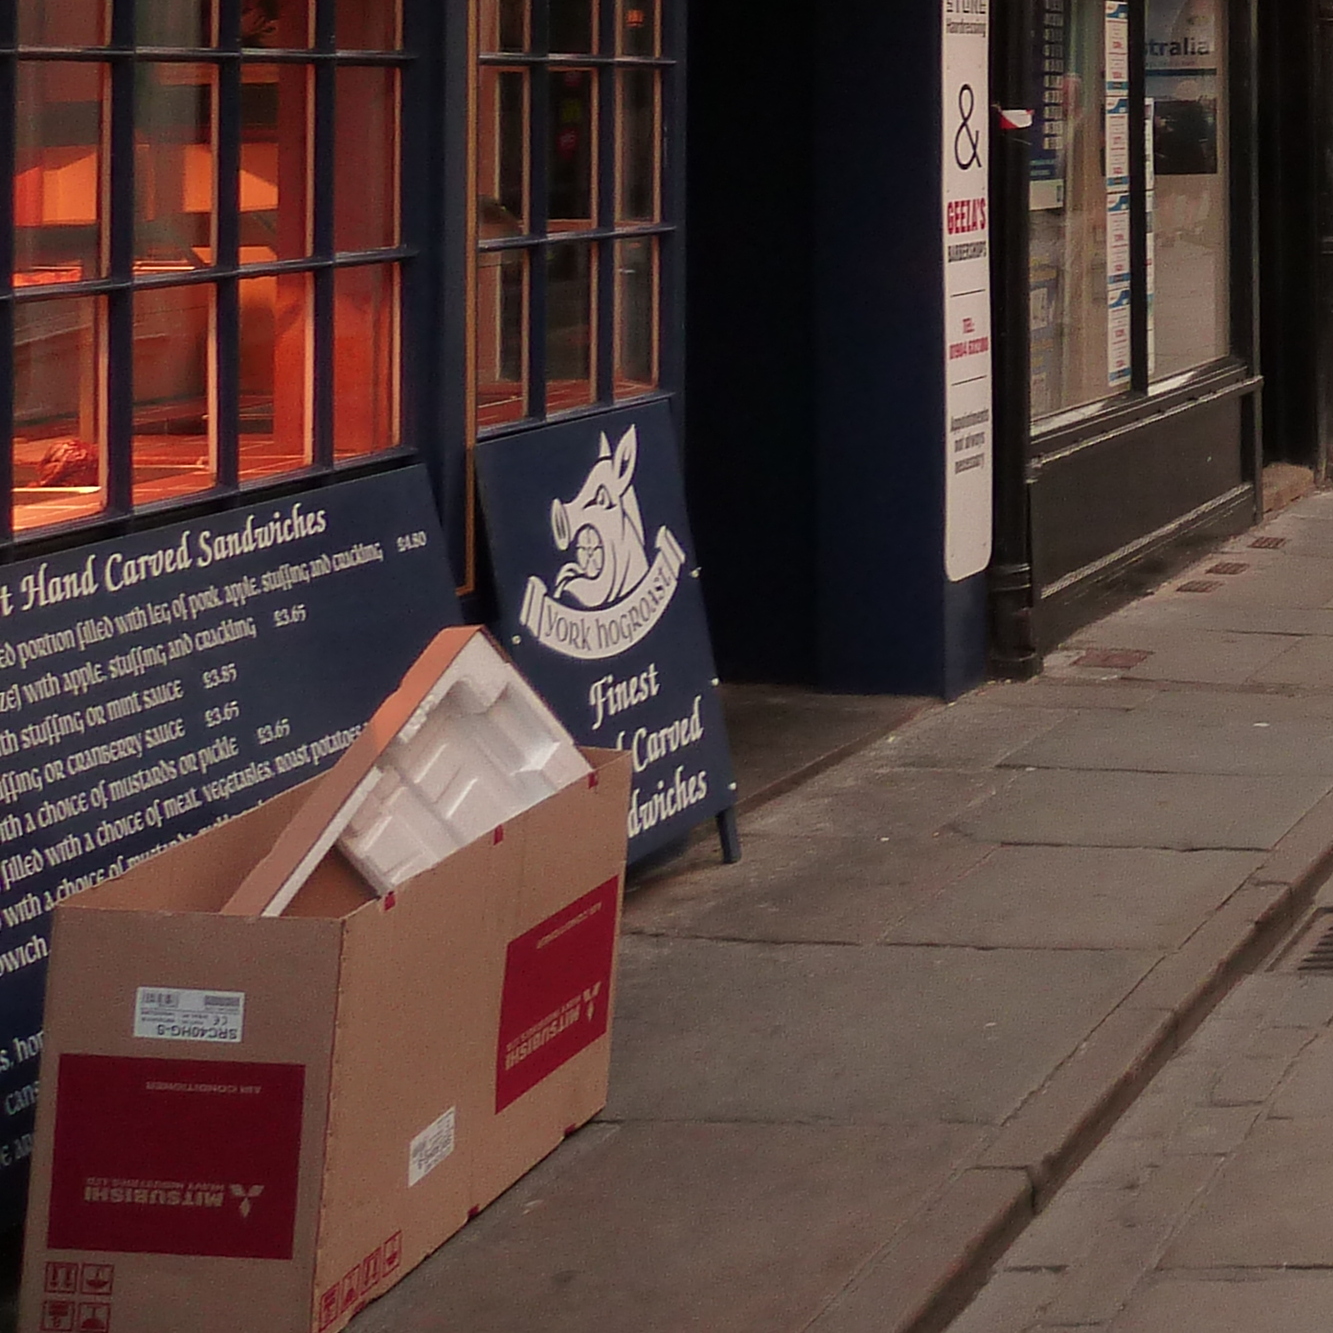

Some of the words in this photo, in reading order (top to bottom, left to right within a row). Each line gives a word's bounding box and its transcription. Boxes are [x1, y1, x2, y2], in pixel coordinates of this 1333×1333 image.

[954, 83, 982, 171] &
[947, 198, 986, 235] GEEZA'S
[20, 555, 99, 612] Hand
[104, 530, 193, 592] Carved
[196, 503, 328, 567] Sandwiches
[17, 629, 75, 671] portion
[76, 621, 115, 651] filled
[115, 606, 147, 634] with
[150, 603, 172, 626] leg
[173, 598, 188, 624] of
[262, 562, 309, 596] stuffing
[310, 554, 331, 577] and
[332, 541, 383, 571] crackling
[397, 530, 427, 553] £4.80
[22, 674, 60, 706] with
[108, 643, 167, 682] stuffing
[168, 634, 193, 660] and
[194, 616, 257, 655] crackling
[273, 603, 307, 628] £3.65
[22, 713, 85, 747] stuffing
[87, 707, 107, 726] or
[107, 692, 142, 718] mint
[142, 679, 184, 709] sauce
[203, 663, 238, 690] £3.85
[588, 663, 662, 731] Finest
[631, 694, 704, 774] Carved
[24, 812, 36, 833] a
[37, 792, 89, 827] choice
[90, 778, 109, 811] of
[108, 759, 178, 802] mustards
[179, 752, 199, 774] or
[199, 735, 239, 774] pickle
[257, 717, 291, 745] £3.65
[44, 759, 66, 784] or
[67, 732, 143, 777] cranberry
[145, 718, 186, 749] sauce
[205, 701, 240, 728] £3.65
[2, 847, 44, 890] filled
[44, 833, 84, 865] with
[84, 832, 96, 851] a
[97, 811, 145, 846] choice
[146, 799, 164, 828] of
[274, 748, 312, 781] roast
[2, 892, 42, 928] with
[505, 1003, 581, 1071] MITSUBISHI
[83, 1186, 224, 1207] MITSUBISHI
